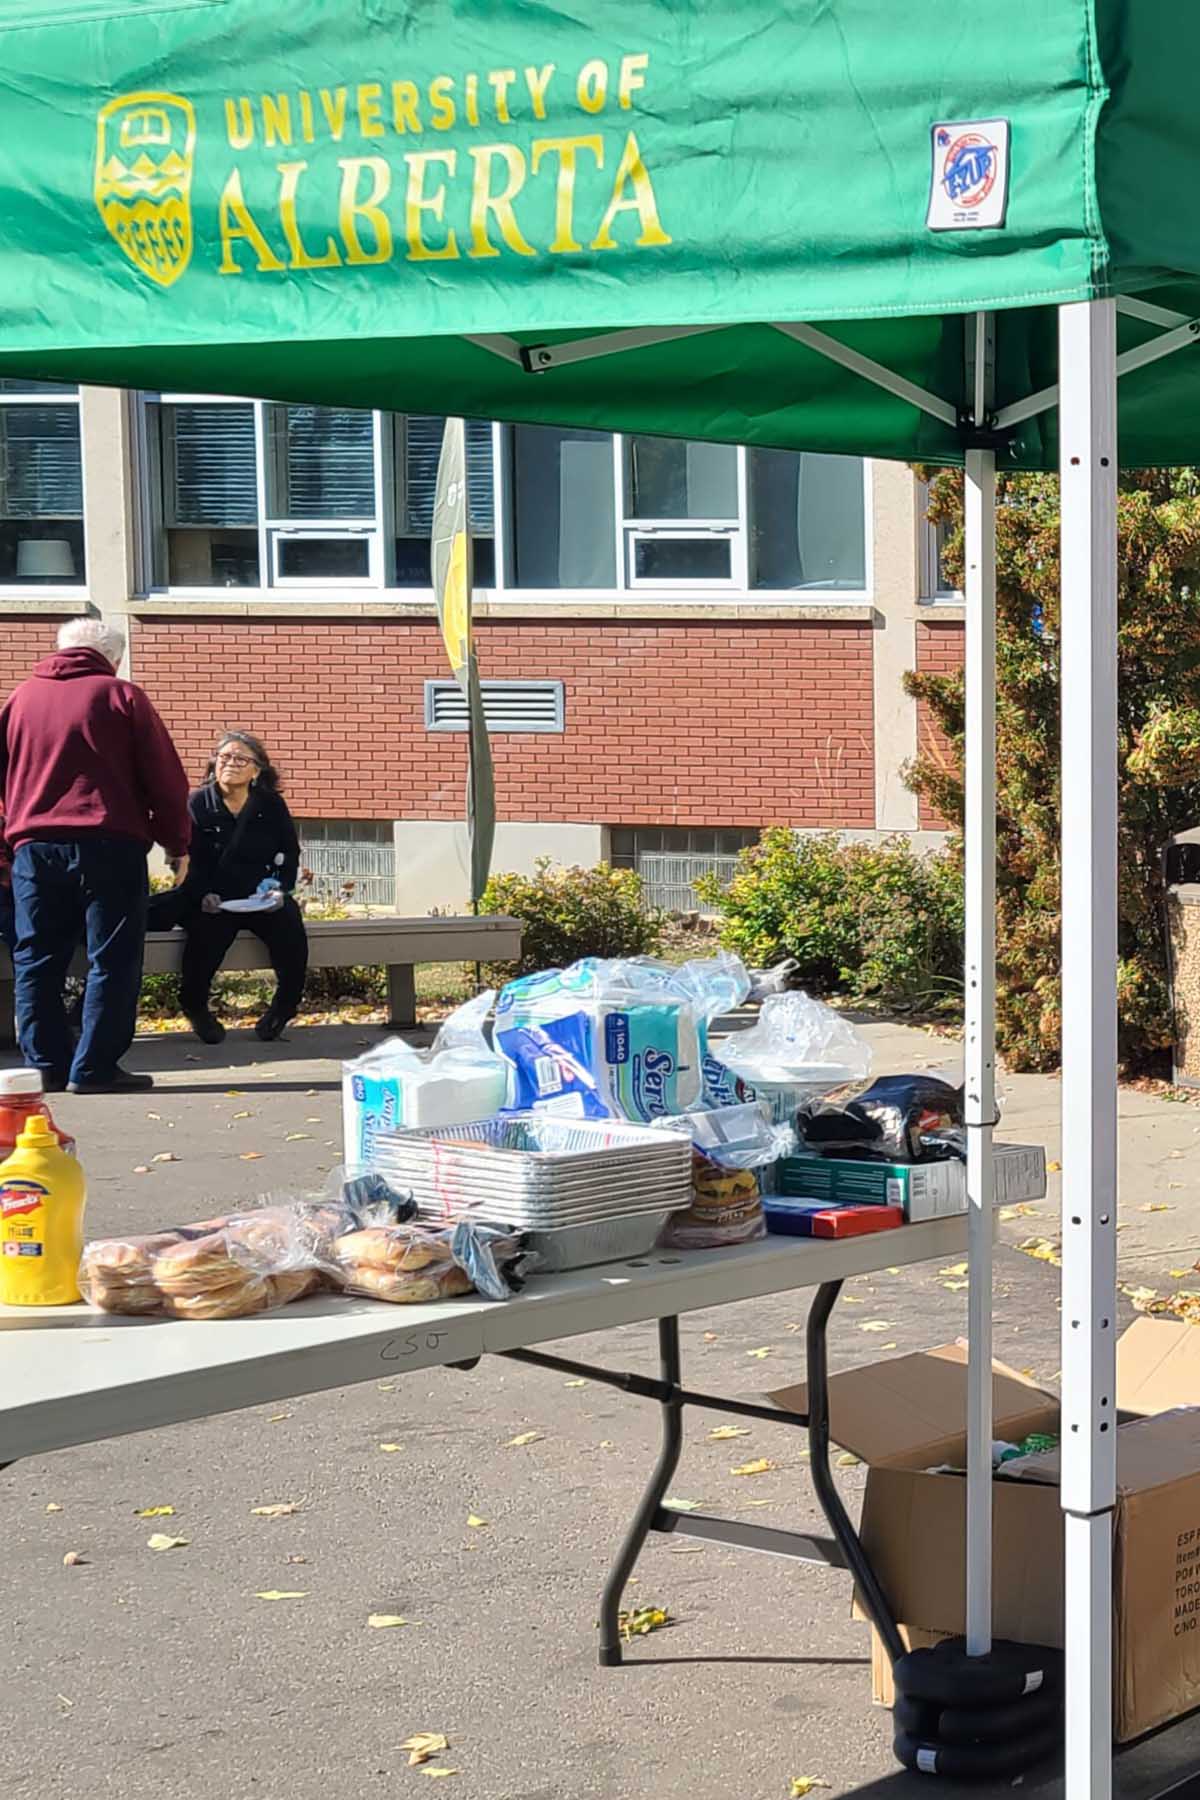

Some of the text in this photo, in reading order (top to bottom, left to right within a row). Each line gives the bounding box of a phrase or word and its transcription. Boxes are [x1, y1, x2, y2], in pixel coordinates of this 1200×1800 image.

[225, 53, 650, 150] UNIVERSITY OF
[217, 130, 672, 274] ALBERTA
[616, 1032, 626, 1061] 1040
[1174, 1598, 1200, 1617] MADE
